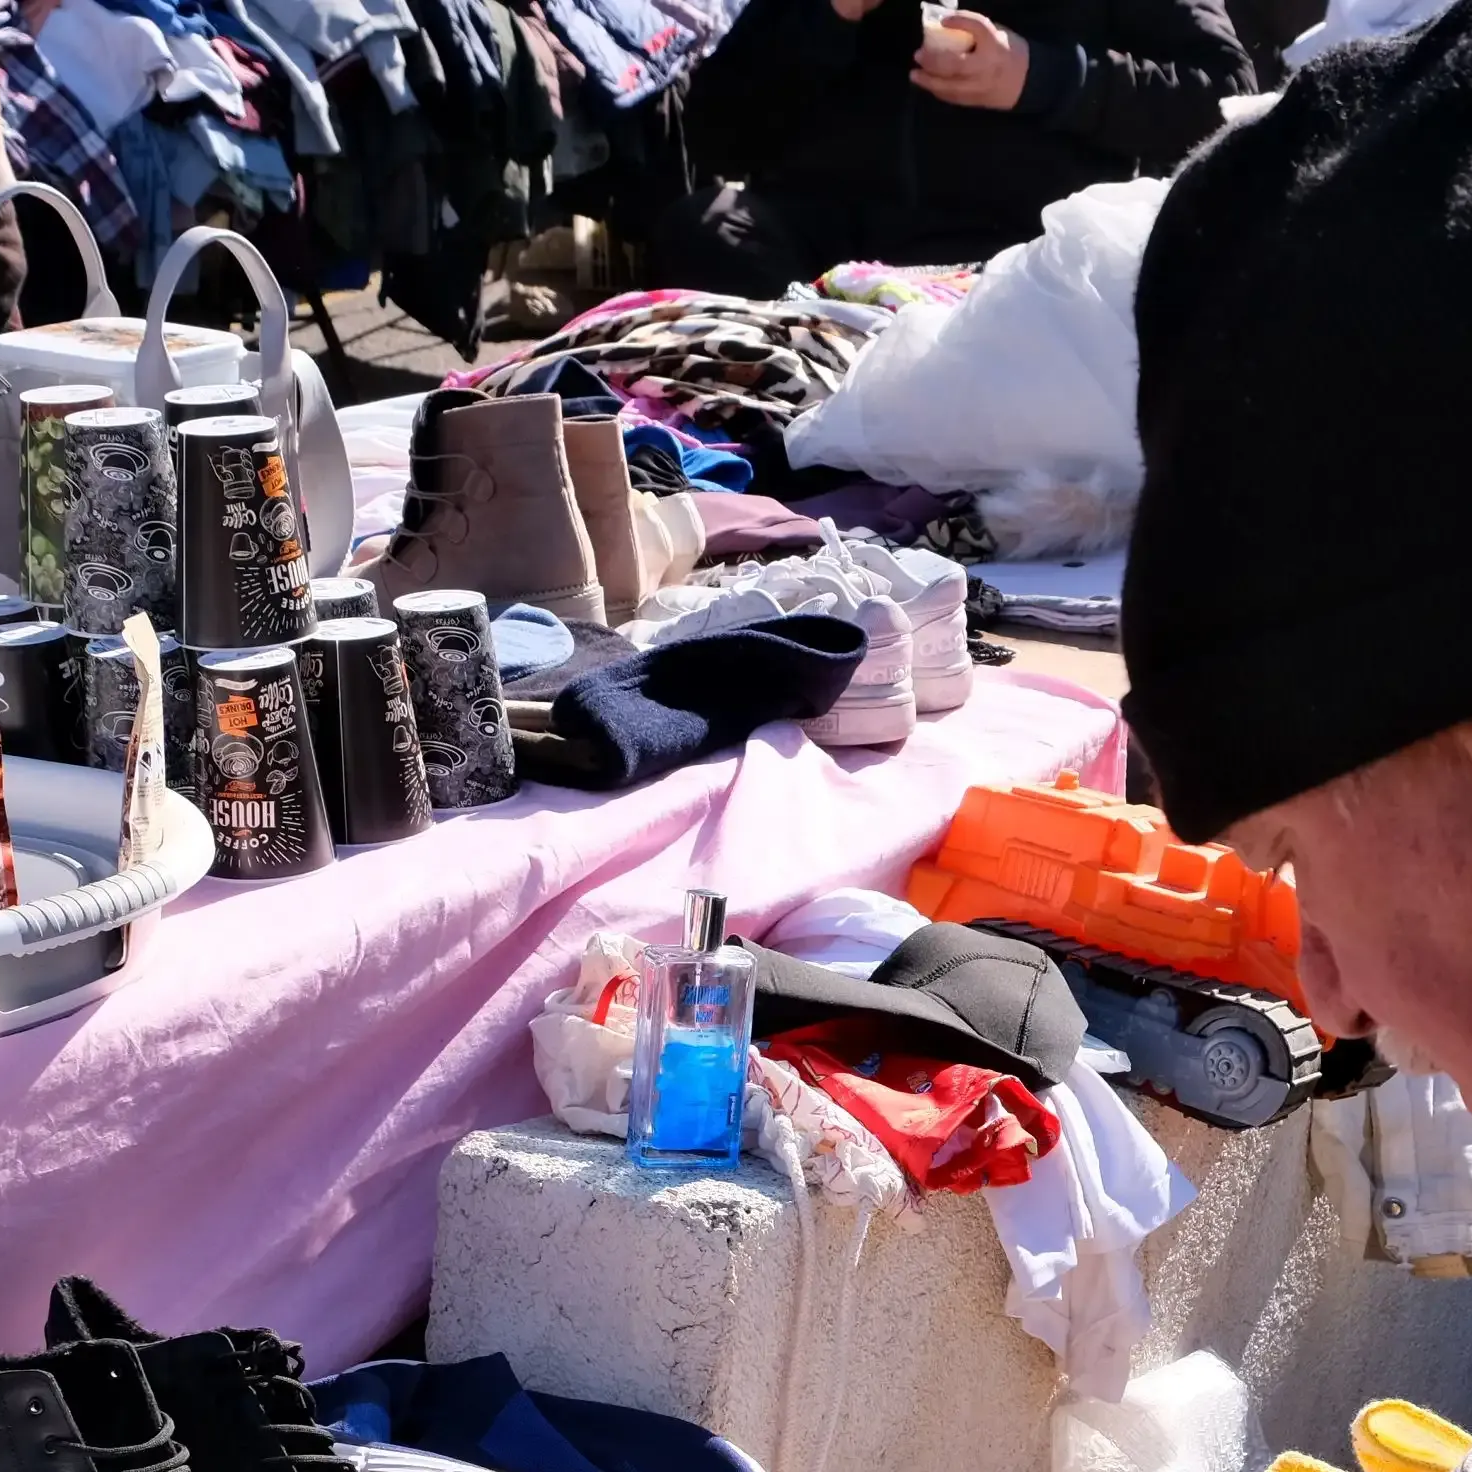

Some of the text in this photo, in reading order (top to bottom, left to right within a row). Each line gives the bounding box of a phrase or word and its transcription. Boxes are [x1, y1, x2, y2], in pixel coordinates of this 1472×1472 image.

[223, 509, 257, 529] Coffee
[259, 680, 293, 709] Coffee
[218, 702, 253, 714] DRINKS
[228, 716, 248, 727] HOT
[209, 798, 276, 829] HOUSE
[217, 832, 269, 850] COFFEE
